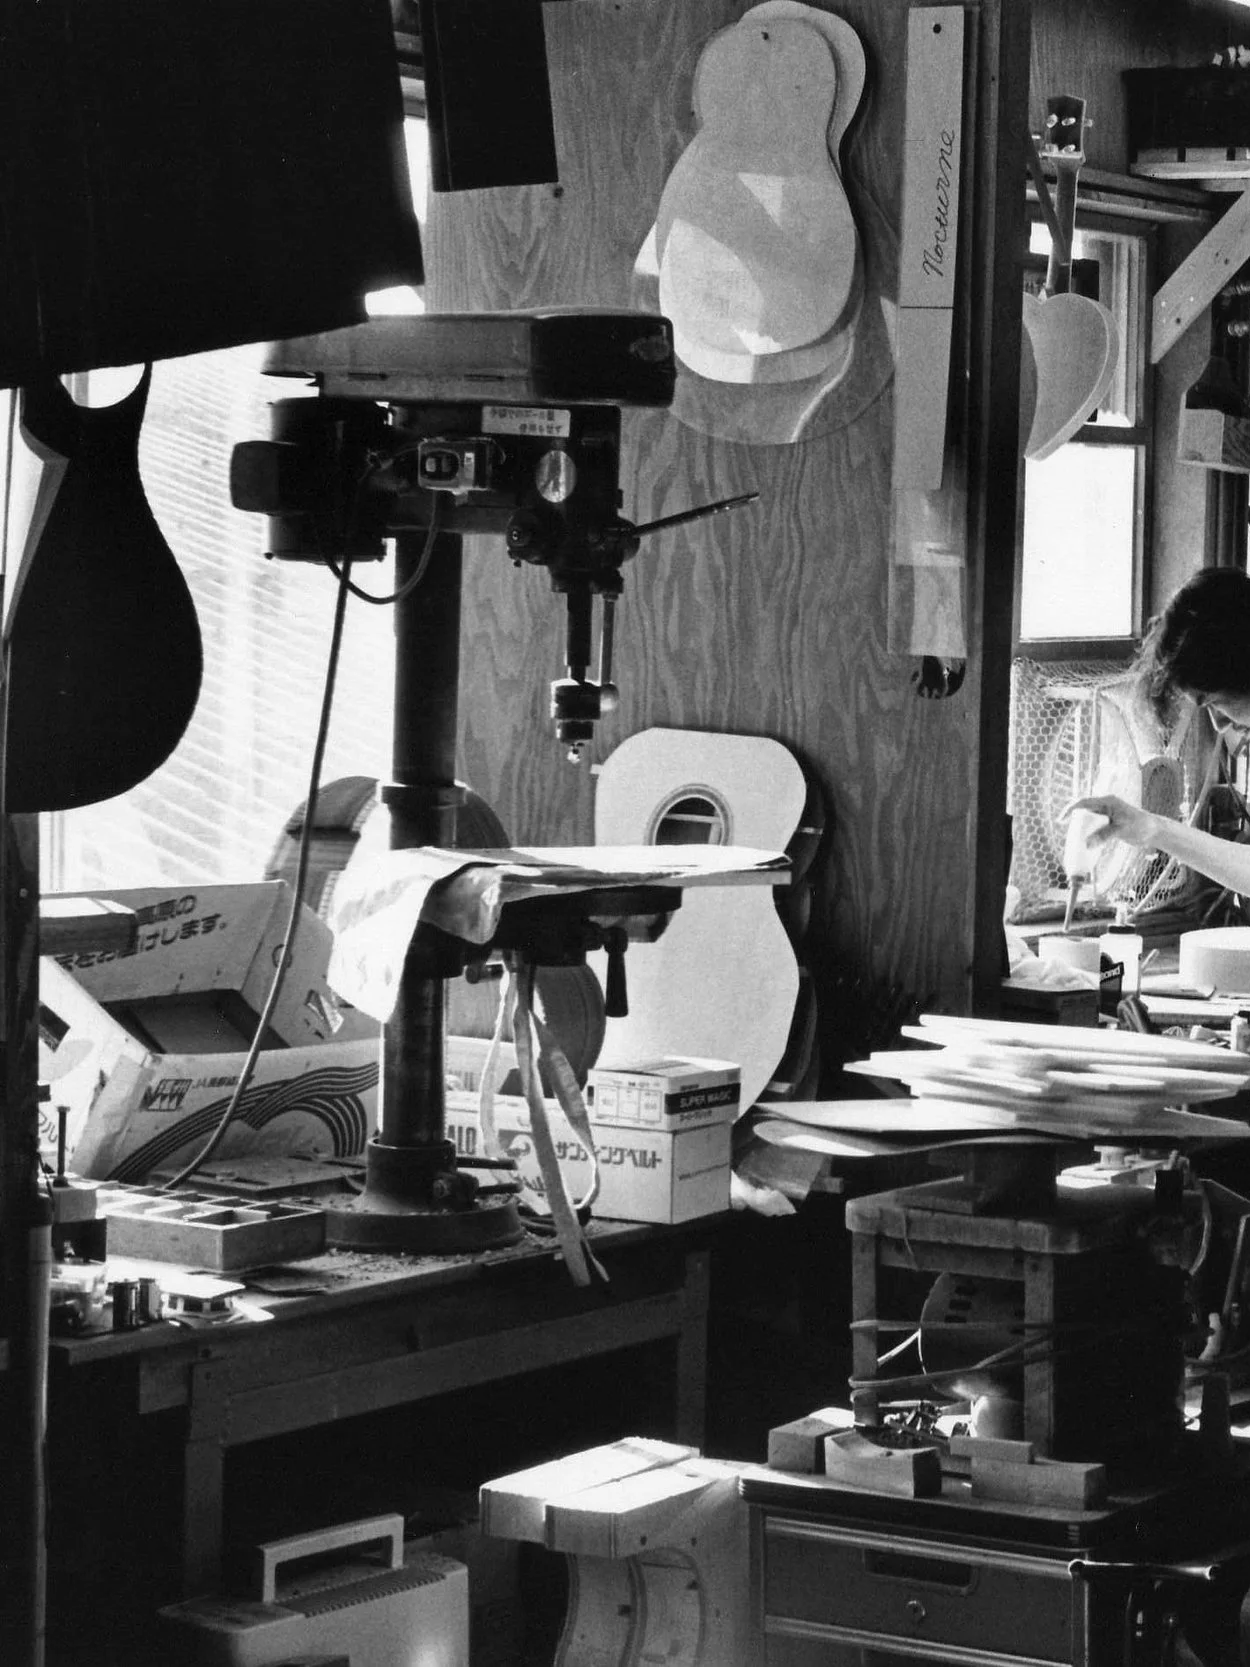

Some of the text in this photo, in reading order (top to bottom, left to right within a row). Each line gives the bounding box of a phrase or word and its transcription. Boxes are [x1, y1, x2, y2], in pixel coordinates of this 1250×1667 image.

[555, 1141, 663, 1169] サンングベルト
